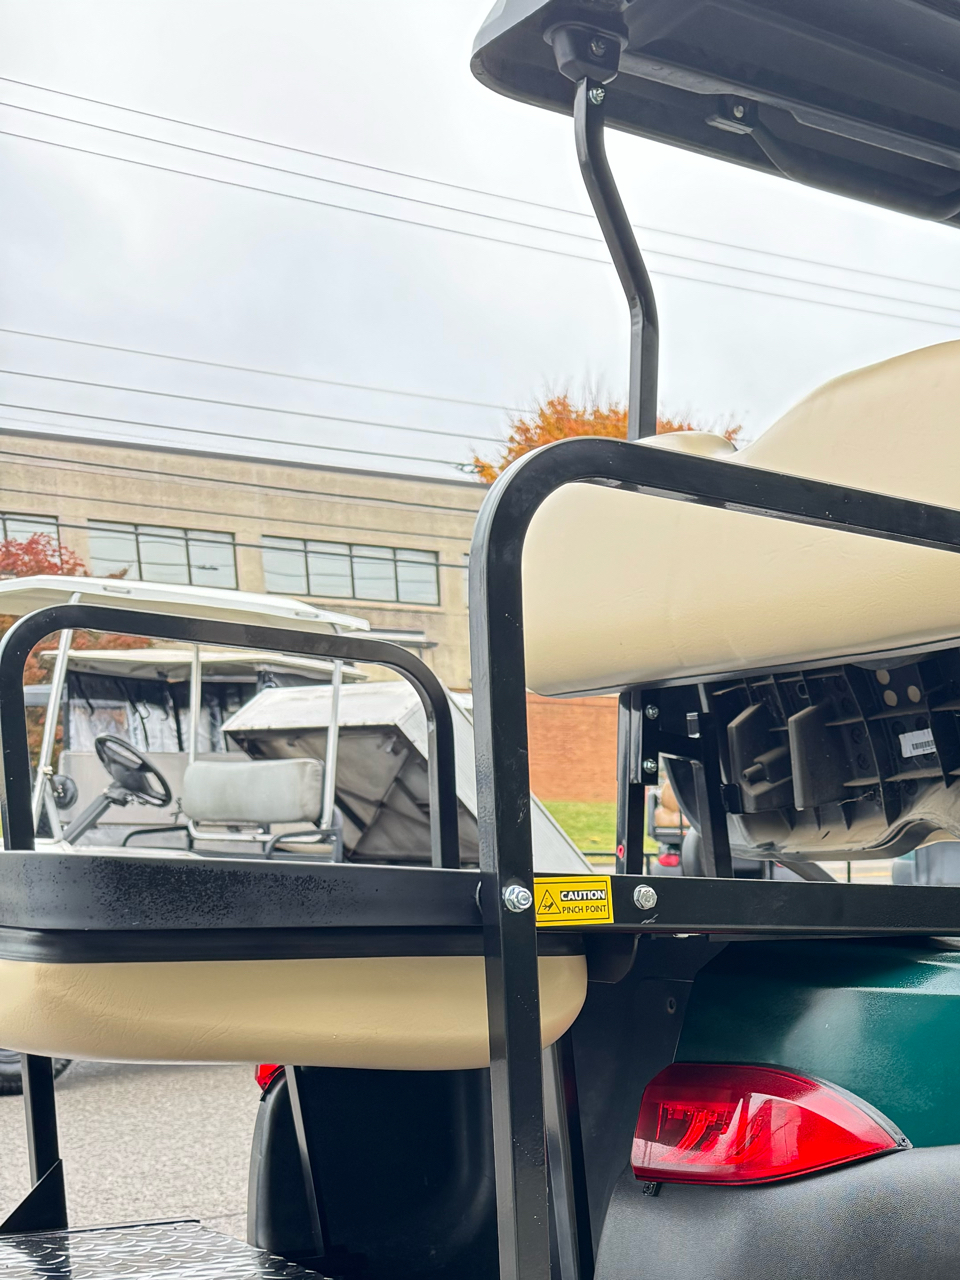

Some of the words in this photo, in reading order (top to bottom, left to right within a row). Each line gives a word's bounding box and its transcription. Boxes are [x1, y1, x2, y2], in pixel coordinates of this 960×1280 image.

[561, 891, 605, 901] CAUTION
[562, 905, 584, 914] PINCH
[585, 904, 607, 913] POINT
